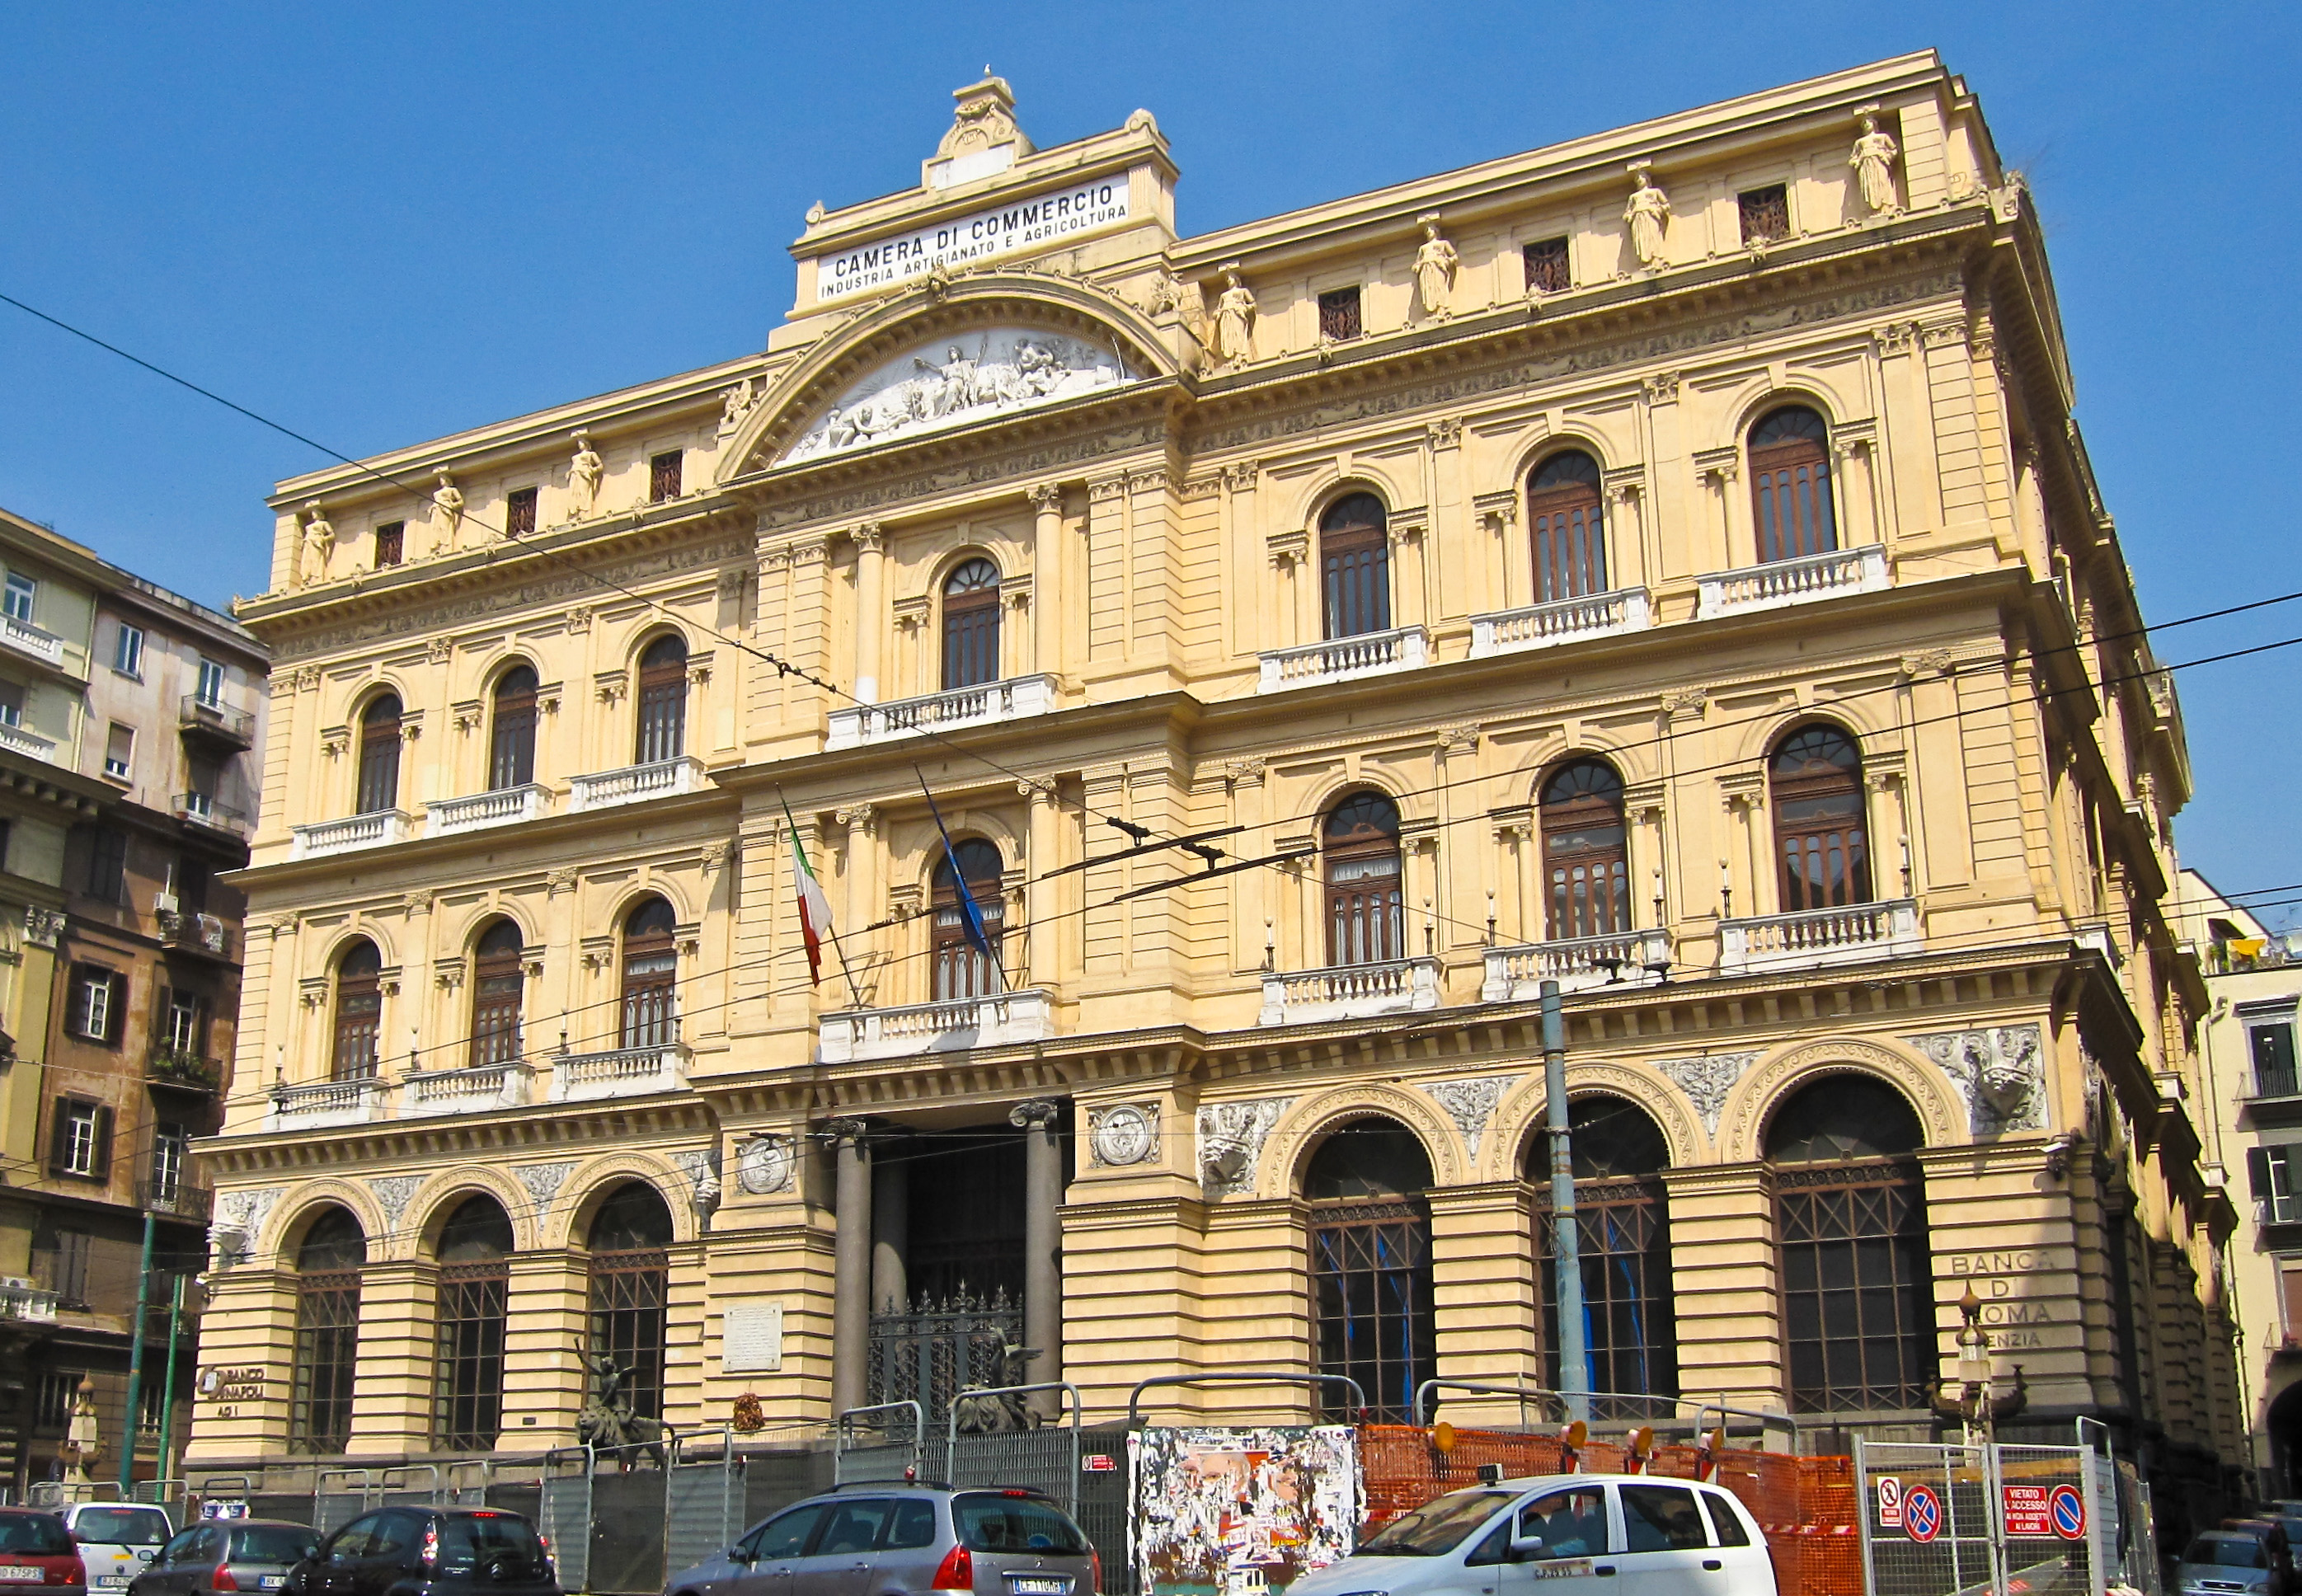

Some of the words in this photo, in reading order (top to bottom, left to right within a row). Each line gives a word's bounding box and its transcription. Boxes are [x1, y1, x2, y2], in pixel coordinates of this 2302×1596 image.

[835, 237, 923, 277] CAMERA
[937, 227, 957, 250] DI
[971, 185, 1112, 240] COMMERCIO
[821, 268, 894, 298] INDUSTRIA
[904, 241, 994, 275] ARTIGIANATO
[1005, 235, 1013, 248] E
[1024, 204, 1126, 242] AGRICOLTURA
[1951, 1252, 2055, 1274] BANCA
[1978, 1303, 2051, 1324] OMA
[2009, 1488, 2040, 1499] VIETATO
[2004, 1500, 2046, 1510] L'ACCESSO
